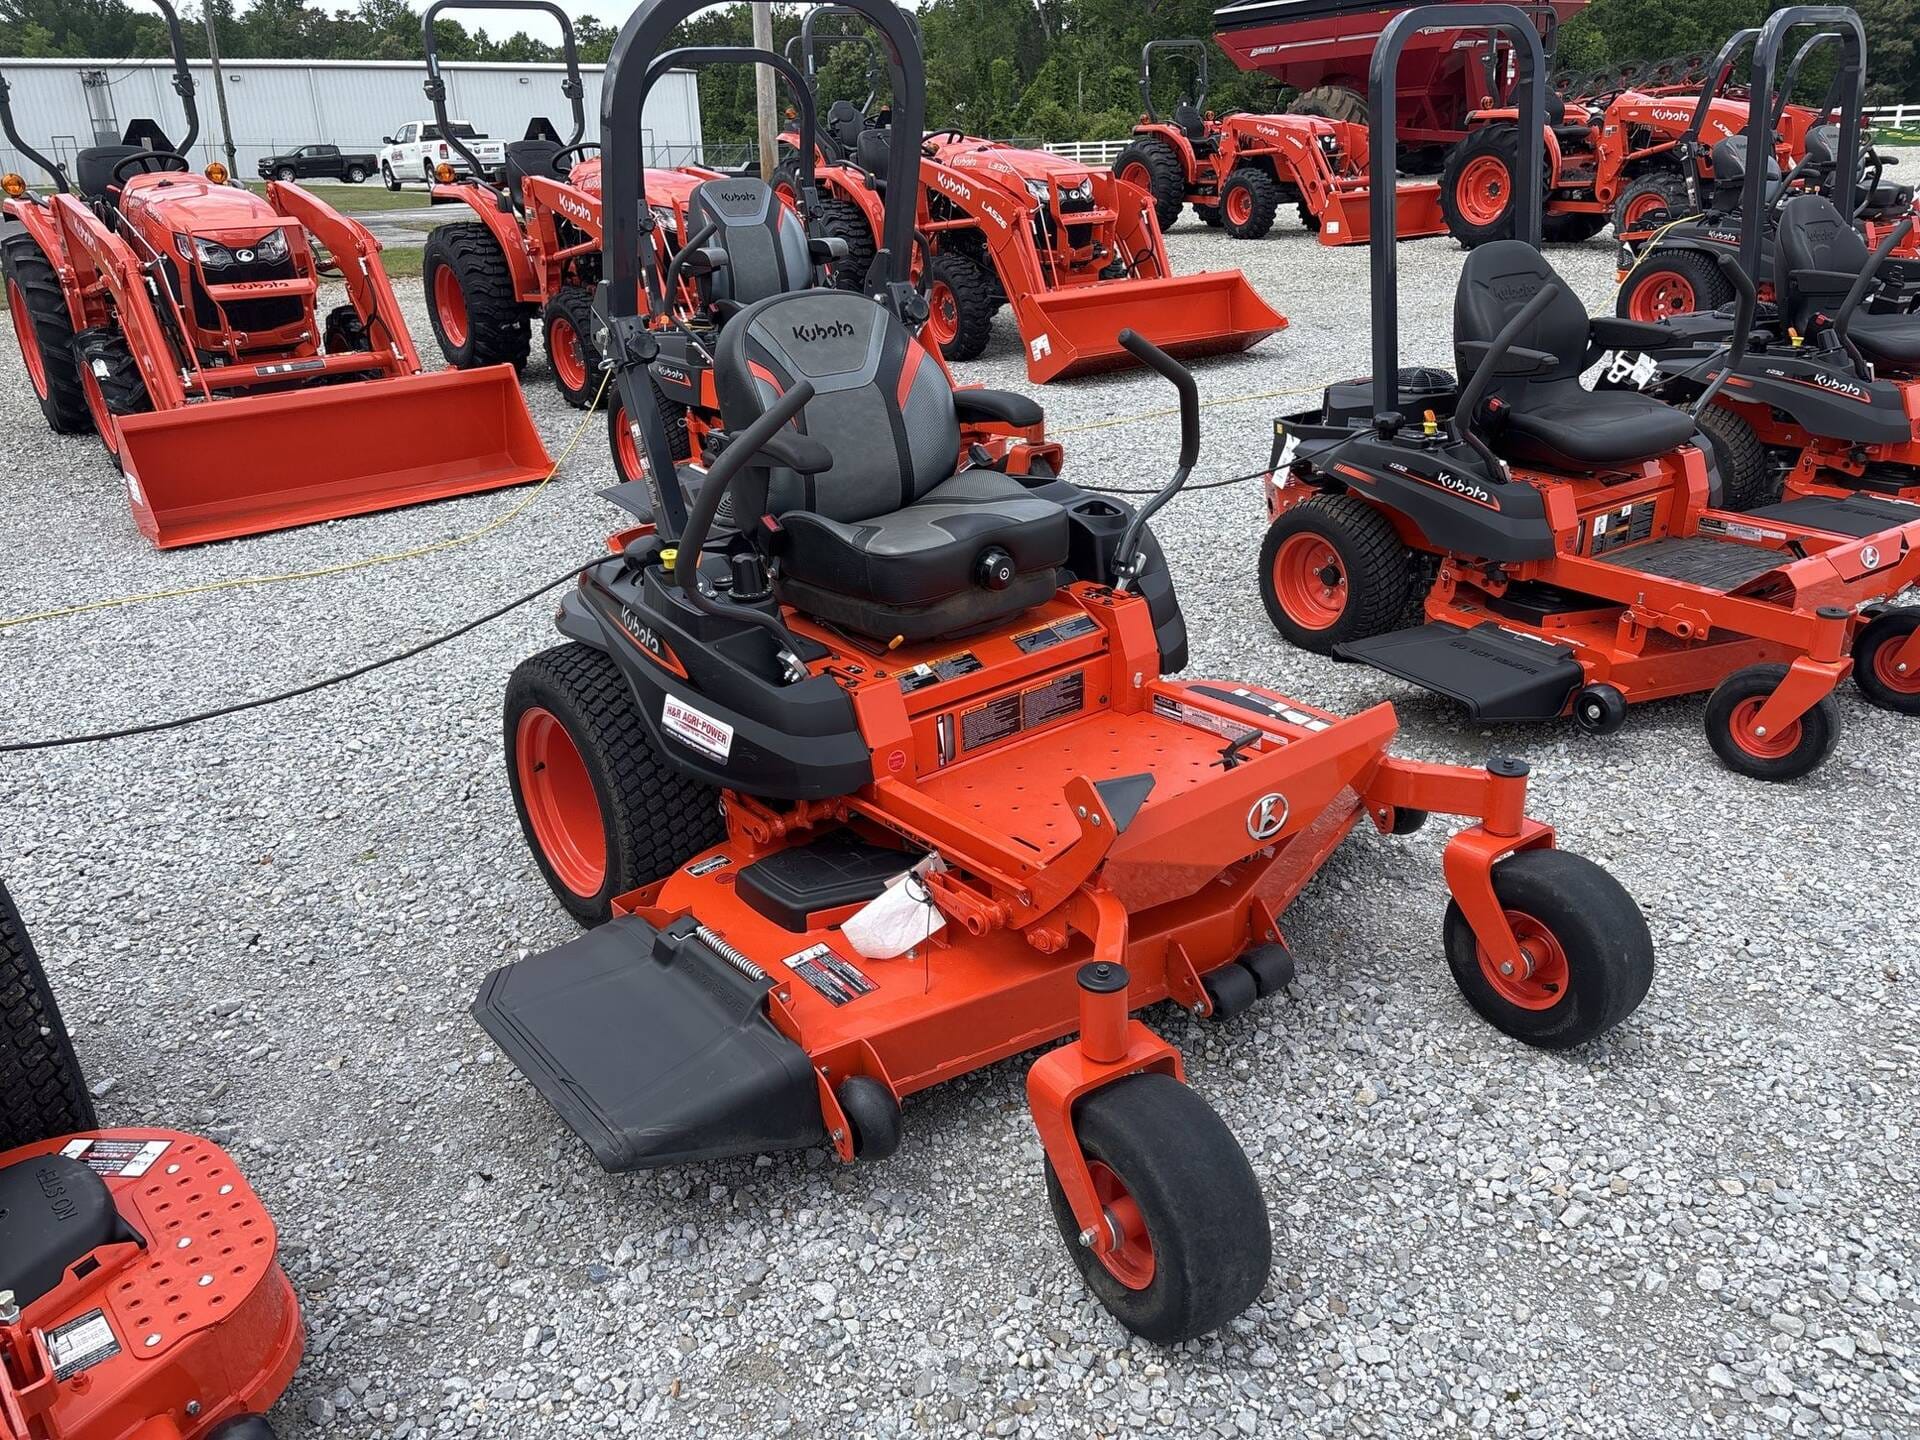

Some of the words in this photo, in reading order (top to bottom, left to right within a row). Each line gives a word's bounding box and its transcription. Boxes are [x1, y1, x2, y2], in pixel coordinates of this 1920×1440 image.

[1651, 109, 1690, 121] Kubota
[1712, 119, 1734, 137] LA76
[720, 191, 756, 202] Kubota
[937, 171, 971, 200] Kubota
[558, 191, 592, 222] Kubota
[981, 200, 1008, 229] LA526
[1708, 230, 1736, 241] Kubota
[792, 319, 855, 342] Kubota
[658, 365, 684, 380] Kubota
[1814, 373, 1860, 396] Kubota
[1437, 472, 1488, 502] Kubota
[621, 604, 660, 654] Kubota
[666, 705, 682, 719] H&R
[35, 1168, 67, 1199] STEP
[51, 1198, 79, 1222] NO
